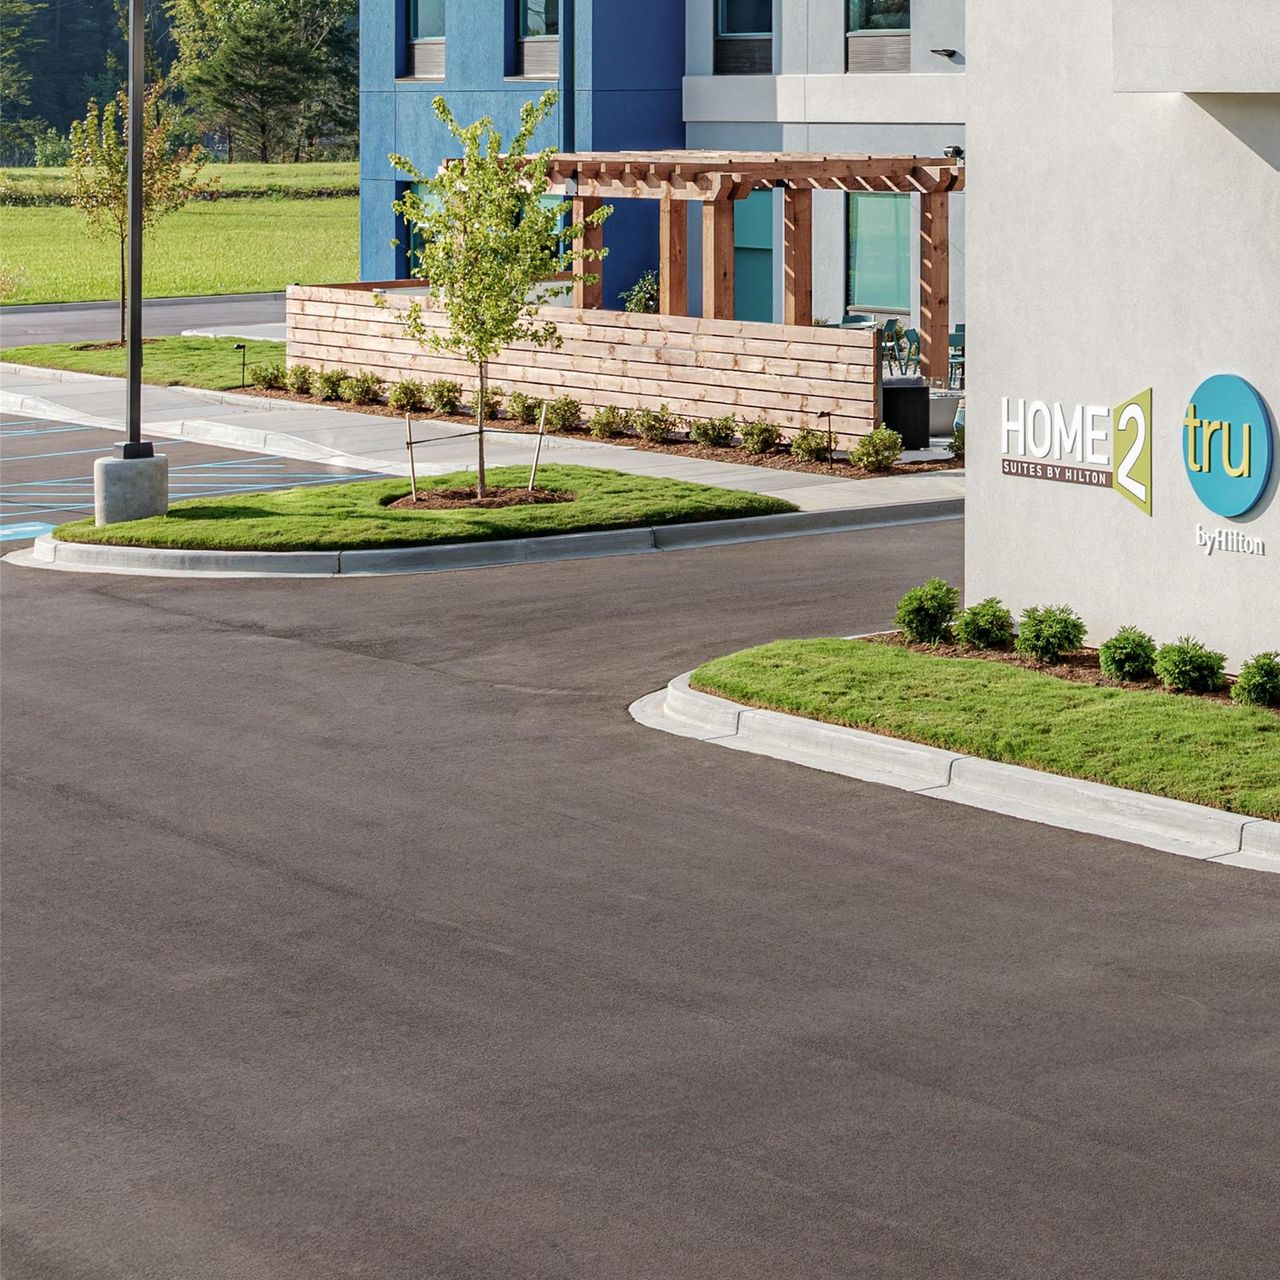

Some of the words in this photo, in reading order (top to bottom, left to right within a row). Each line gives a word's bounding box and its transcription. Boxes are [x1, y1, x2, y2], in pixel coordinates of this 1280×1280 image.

[1183, 403, 1250, 477] tru
[1003, 461, 1042, 476] SUITES
[1047, 468, 1061, 479] BY
[1065, 472, 1106, 485] HILTON
